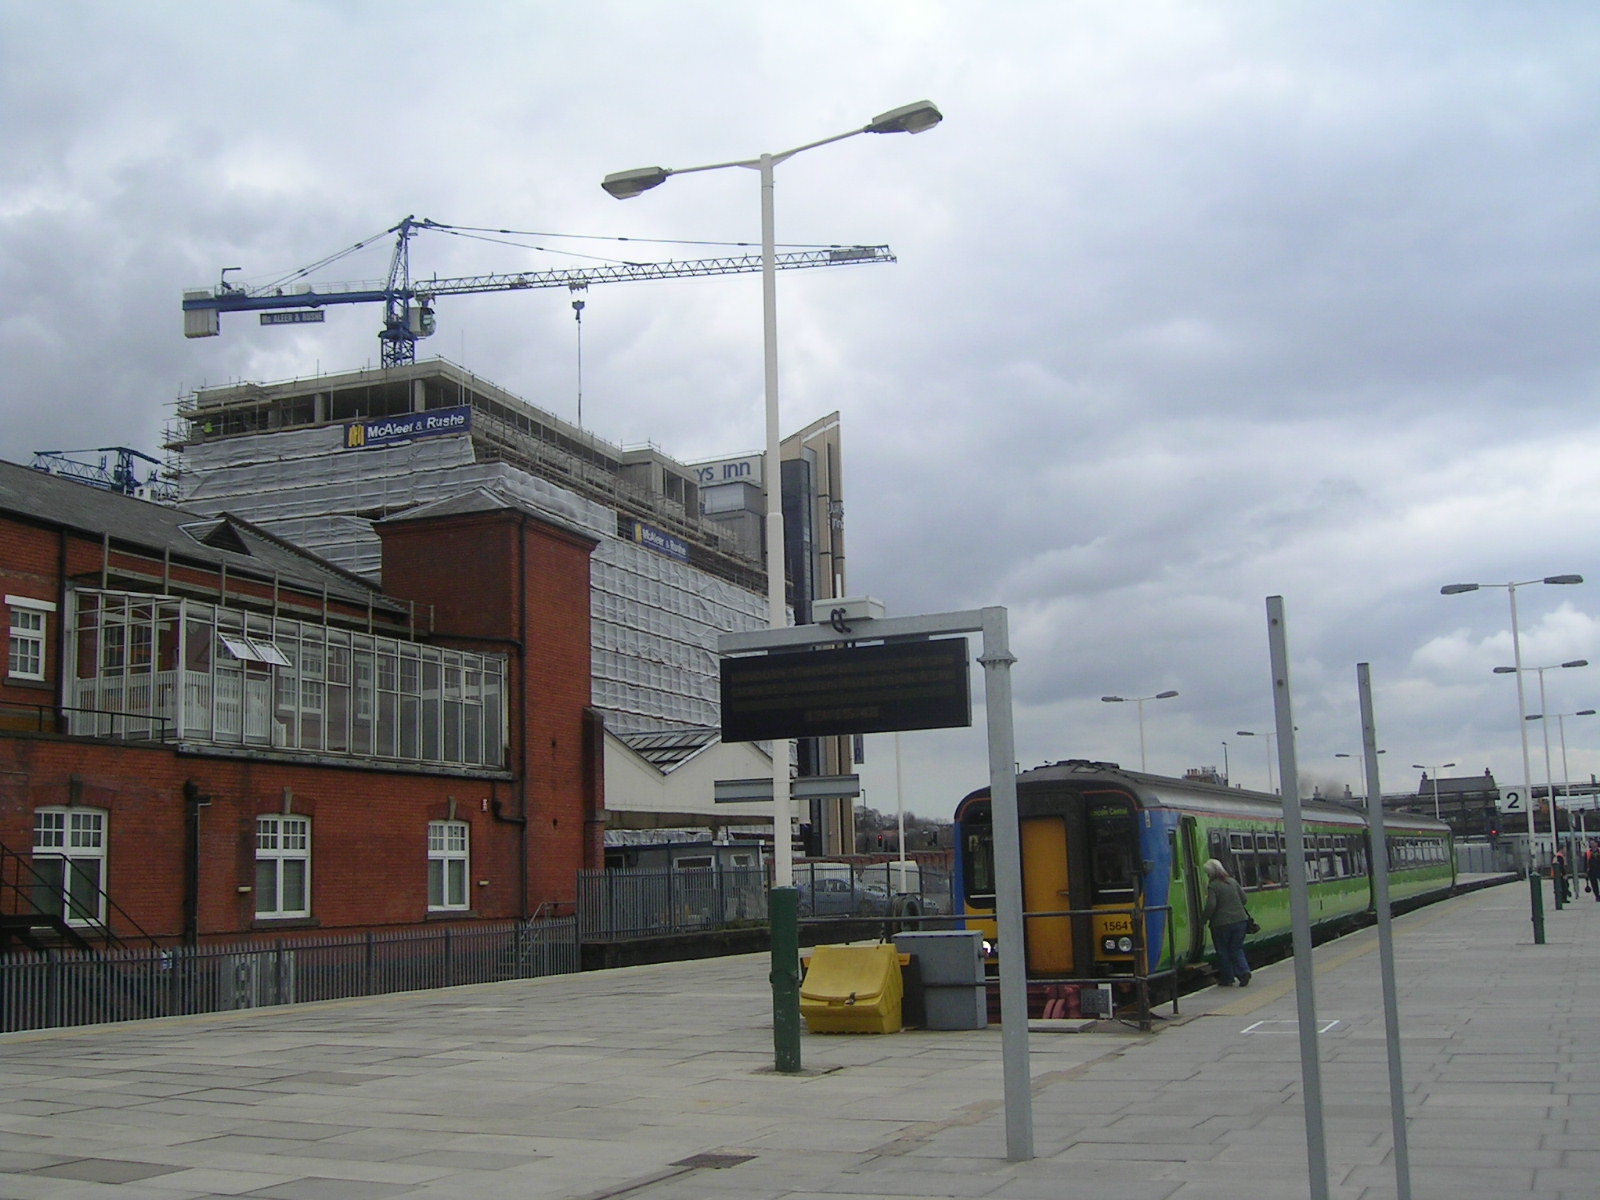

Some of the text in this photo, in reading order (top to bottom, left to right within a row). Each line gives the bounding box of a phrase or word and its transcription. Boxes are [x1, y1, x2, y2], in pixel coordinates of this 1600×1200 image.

[367, 415, 465, 438] McAleer & Rushe
[1506, 792, 1520, 809] 2
